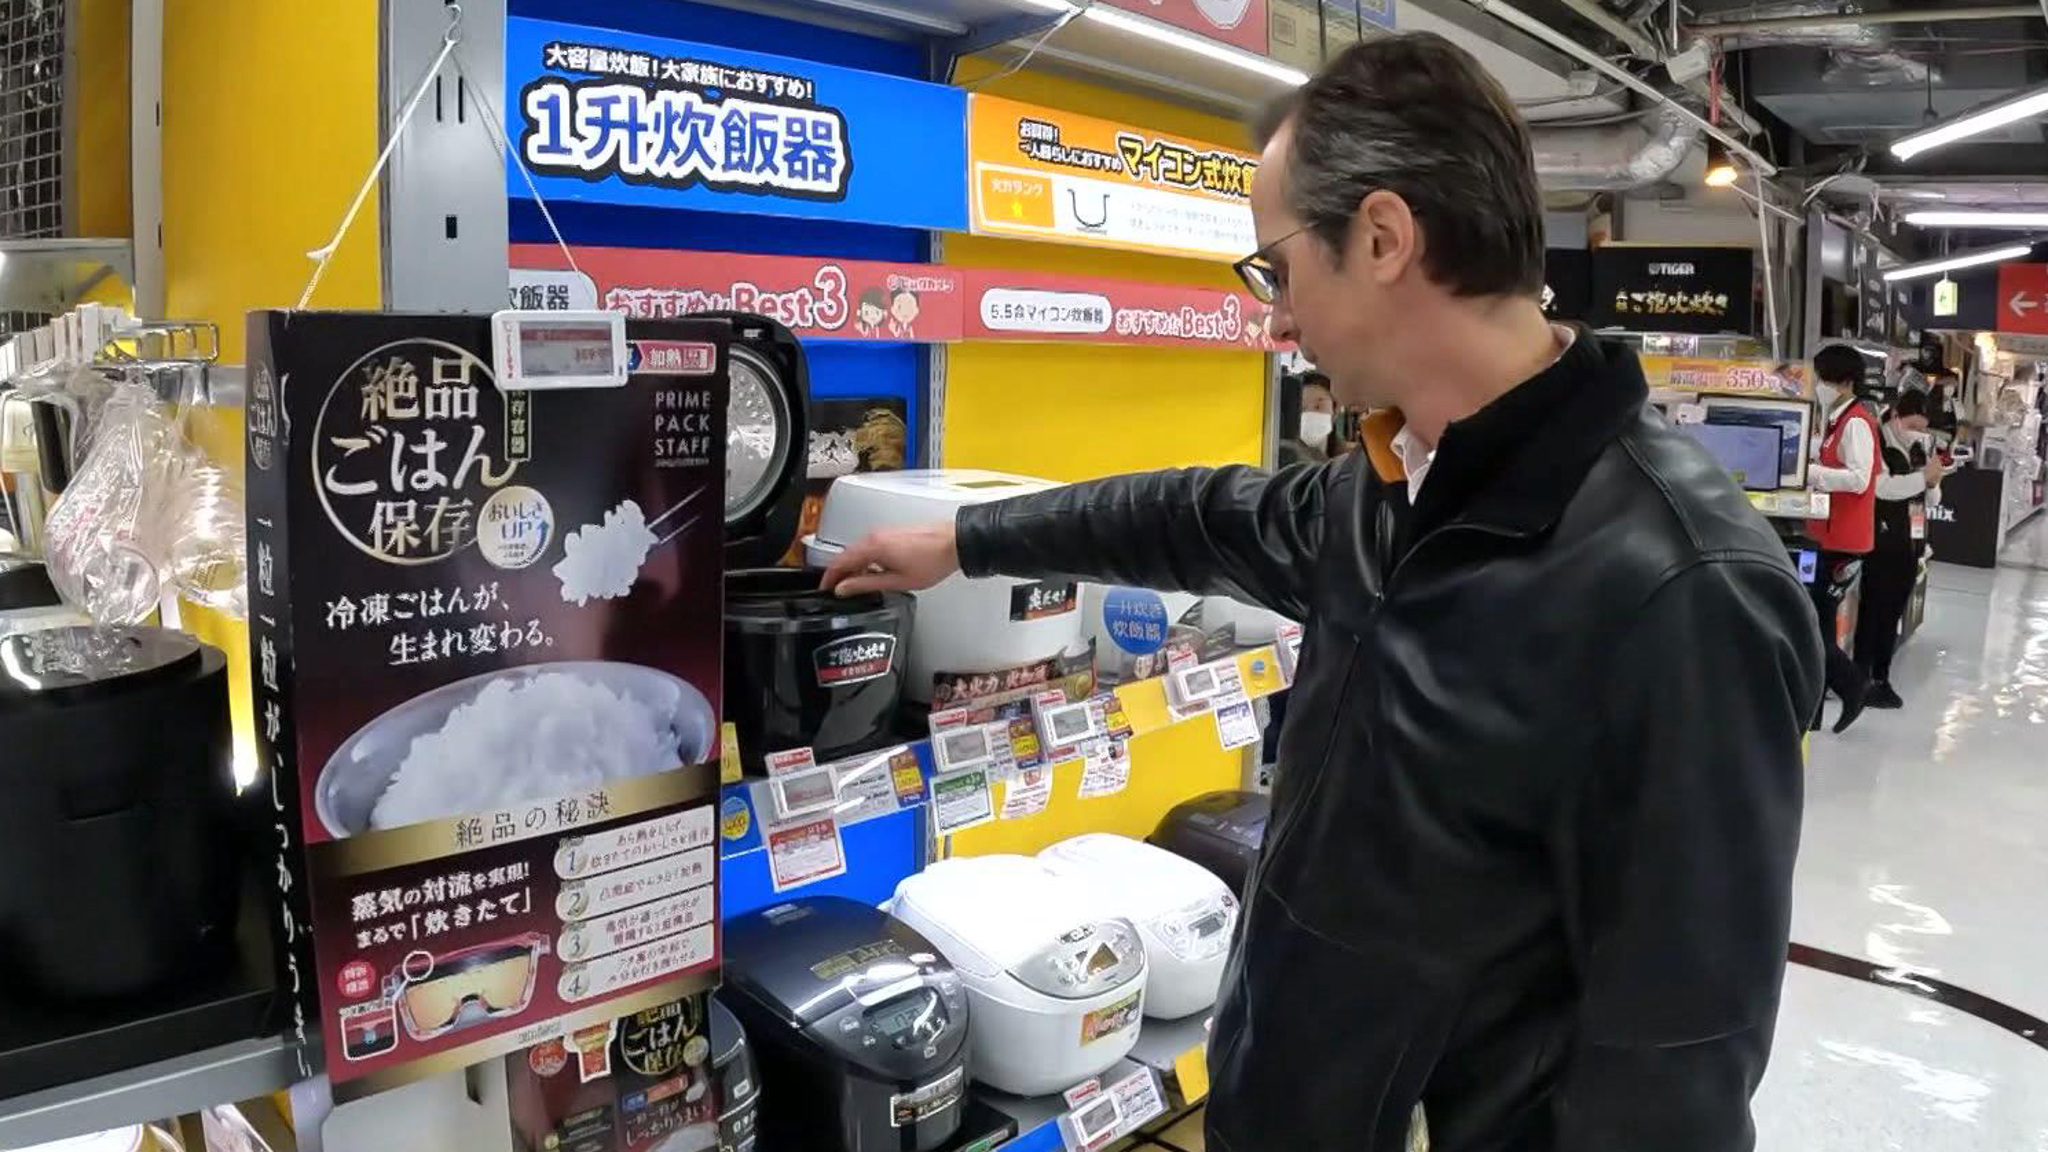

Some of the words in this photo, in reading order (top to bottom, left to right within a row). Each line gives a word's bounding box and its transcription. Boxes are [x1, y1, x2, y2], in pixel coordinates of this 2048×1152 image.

[530, 88, 843, 188] 1升炊飯器
[1658, 262, 1696, 276] TIGER
[360, 356, 479, 422] 絶品
[655, 390, 711, 409] PRIME
[655, 413, 710, 432] PACK
[655, 436, 710, 456] STAFF
[324, 424, 515, 496] ごはん
[488, 501, 542, 523] おいしさ
[366, 497, 476, 555] 保存
[502, 521, 533, 540] UP
[326, 580, 511, 631] 冷凍ごはんが、
[389, 618, 556, 667] 生まれ変わる。
[1111, 620, 1161, 642] 炊飯器
[456, 792, 611, 850] 絶品の秘訣
[351, 861, 530, 923] 蒸気の対流を実現!
[567, 892, 582, 917] 2
[355, 886, 532, 949] まるで「炊きたて」
[572, 934, 582, 957] 3
[567, 973, 582, 997] 4
